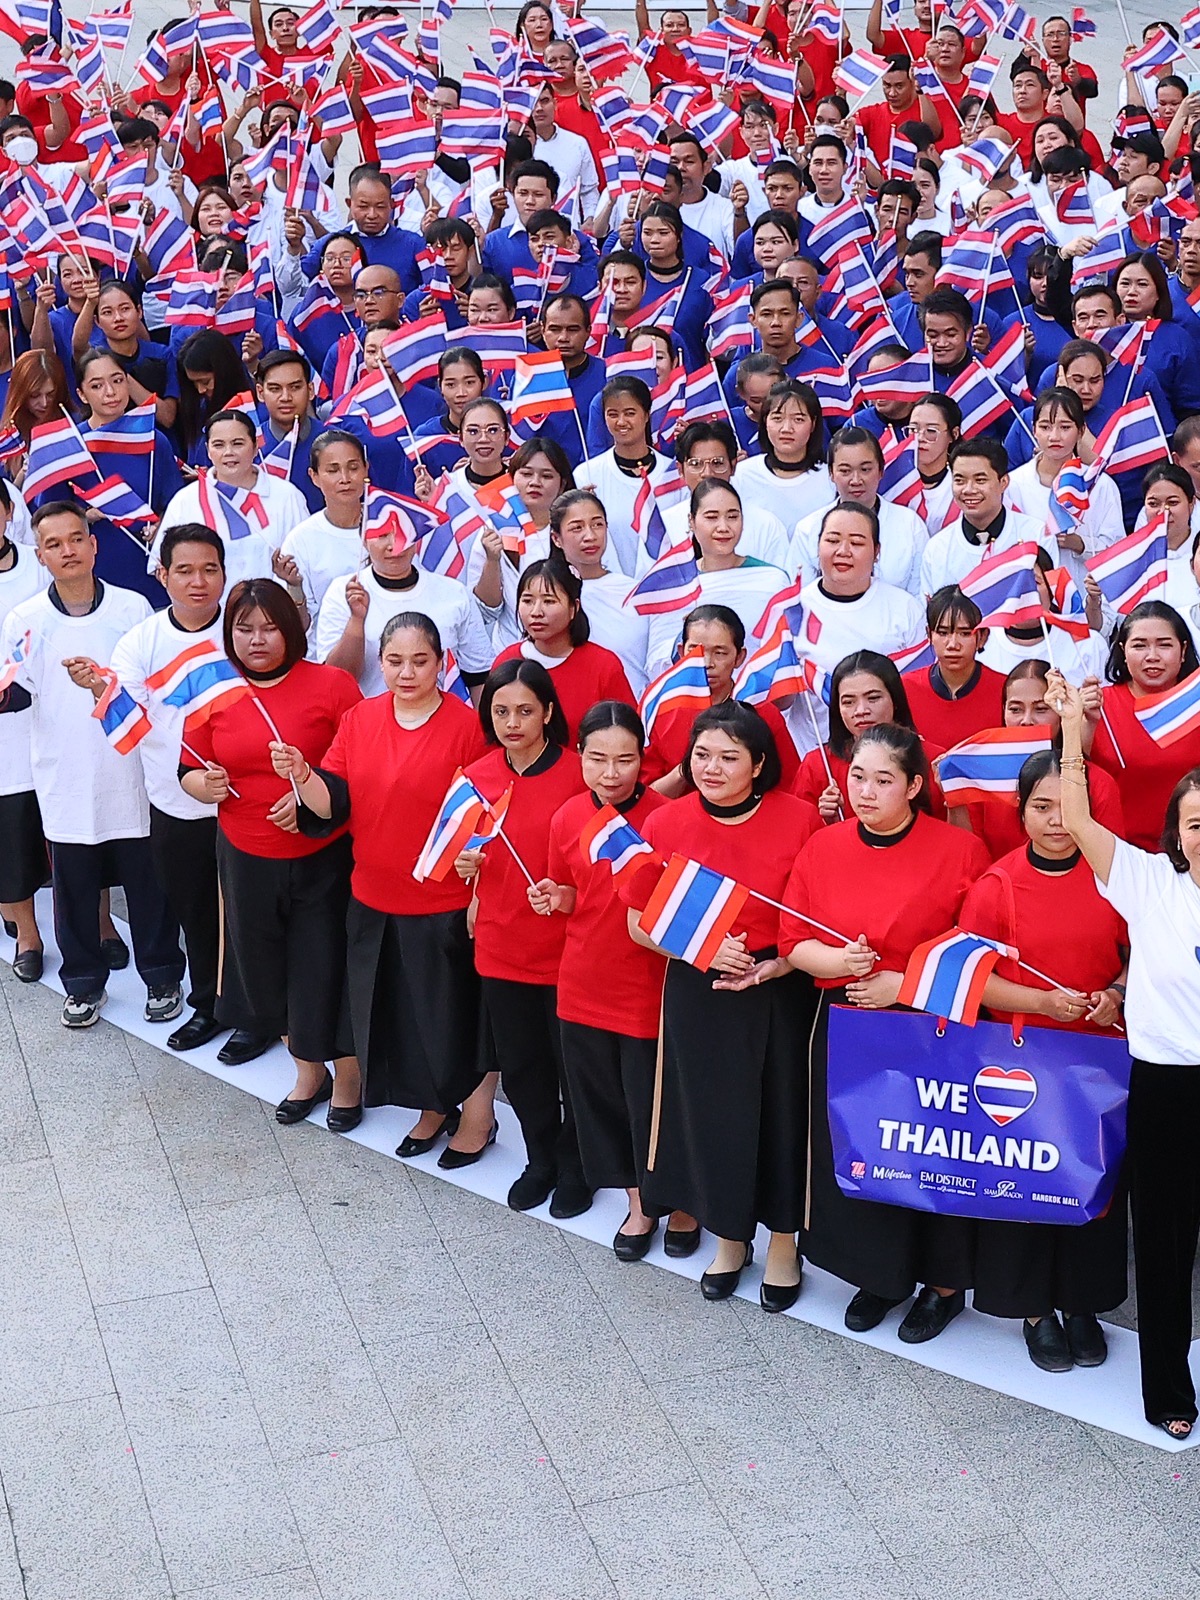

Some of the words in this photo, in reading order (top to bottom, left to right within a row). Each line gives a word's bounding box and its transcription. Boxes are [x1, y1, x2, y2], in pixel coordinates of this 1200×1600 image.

[915, 1077, 969, 1115] WE
[878, 1118, 1061, 1172] THAILAND
[920, 1171, 934, 1183] EM
[935, 1173, 977, 1189] DISTRICT
[1031, 1193, 1062, 1204] BANGKOK
[1062, 1197, 1079, 1207] MALL
